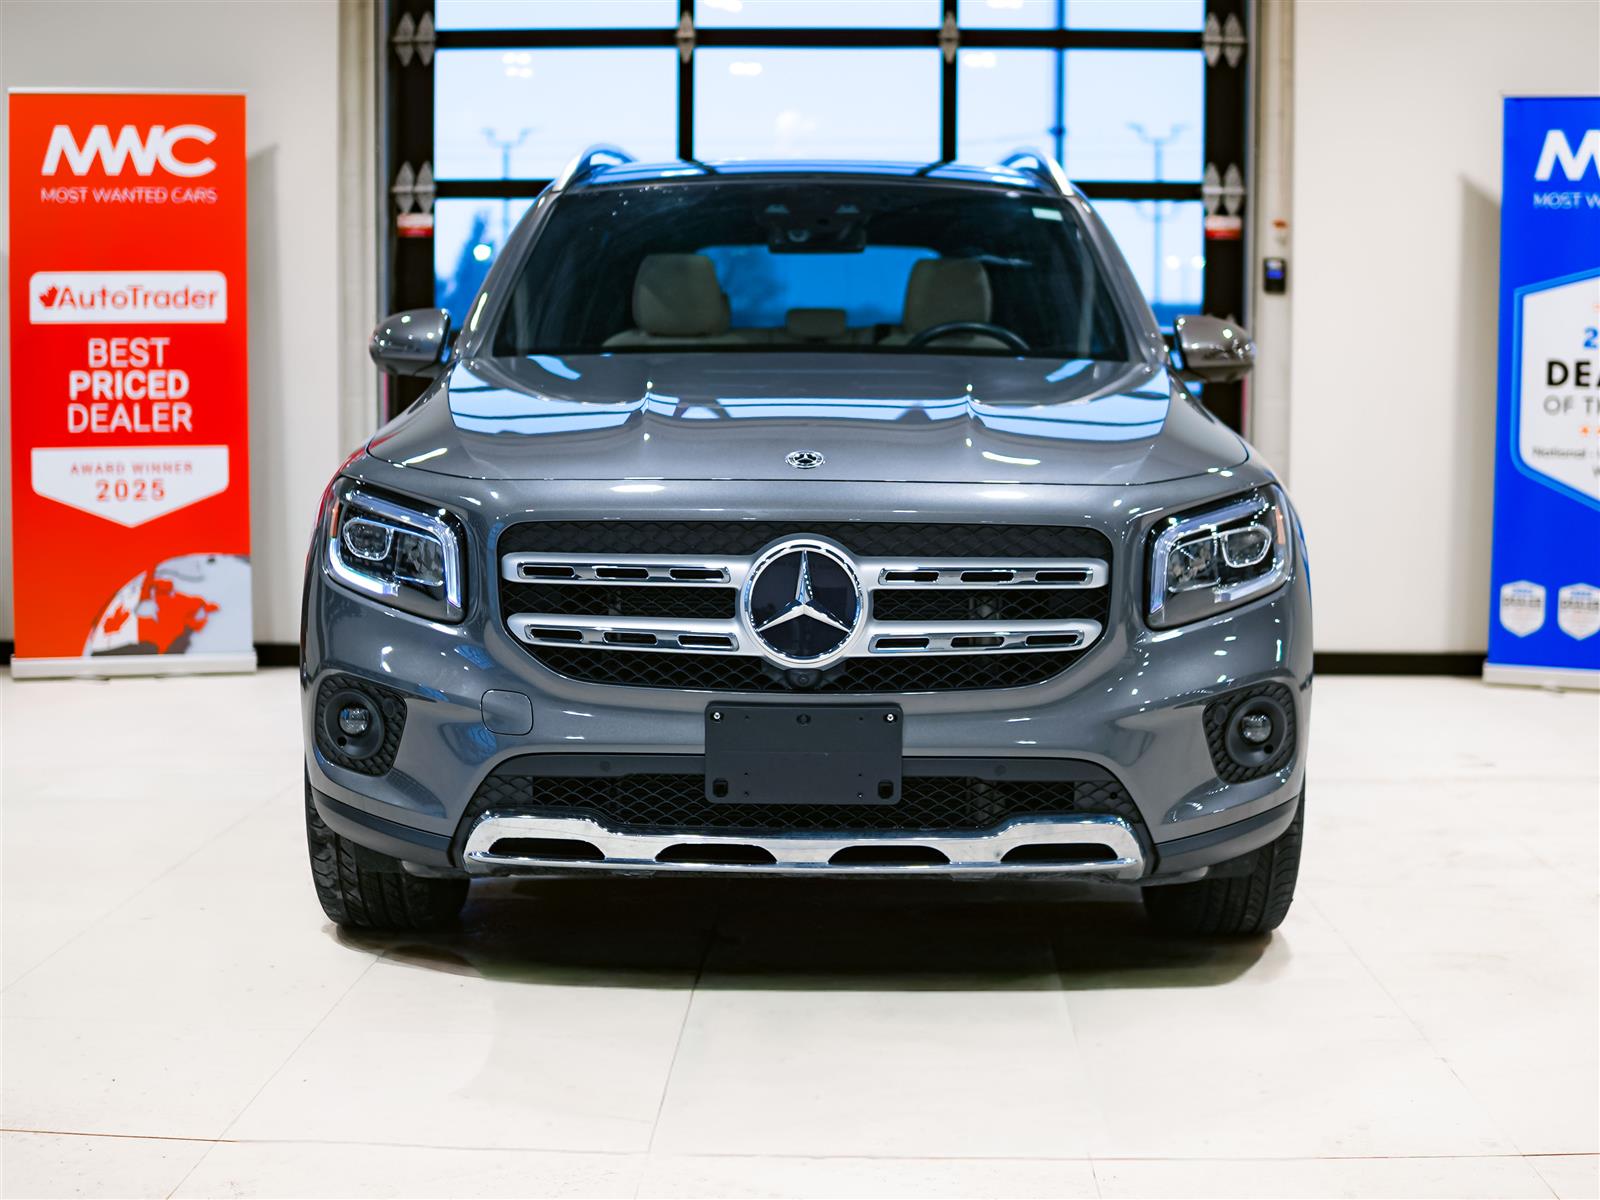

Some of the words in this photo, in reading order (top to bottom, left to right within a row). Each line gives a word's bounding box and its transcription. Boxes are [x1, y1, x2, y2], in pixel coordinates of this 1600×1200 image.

[41, 124, 217, 178] MWC
[40, 186, 88, 204] MOST
[92, 186, 168, 204] WANTED
[170, 187, 218, 204] CARS
[1533, 191, 1582, 209] MOST
[58, 285, 217, 309] AutoTrader
[88, 337, 171, 368] BEST
[69, 369, 190, 400] PRICED
[1547, 360, 1600, 388] DE
[67, 402, 193, 433] DEALER
[1543, 395, 1574, 416] OF
[70, 463, 126, 475] AWARD
[131, 462, 193, 474] WINNER
[95, 478, 166, 502] 2025
